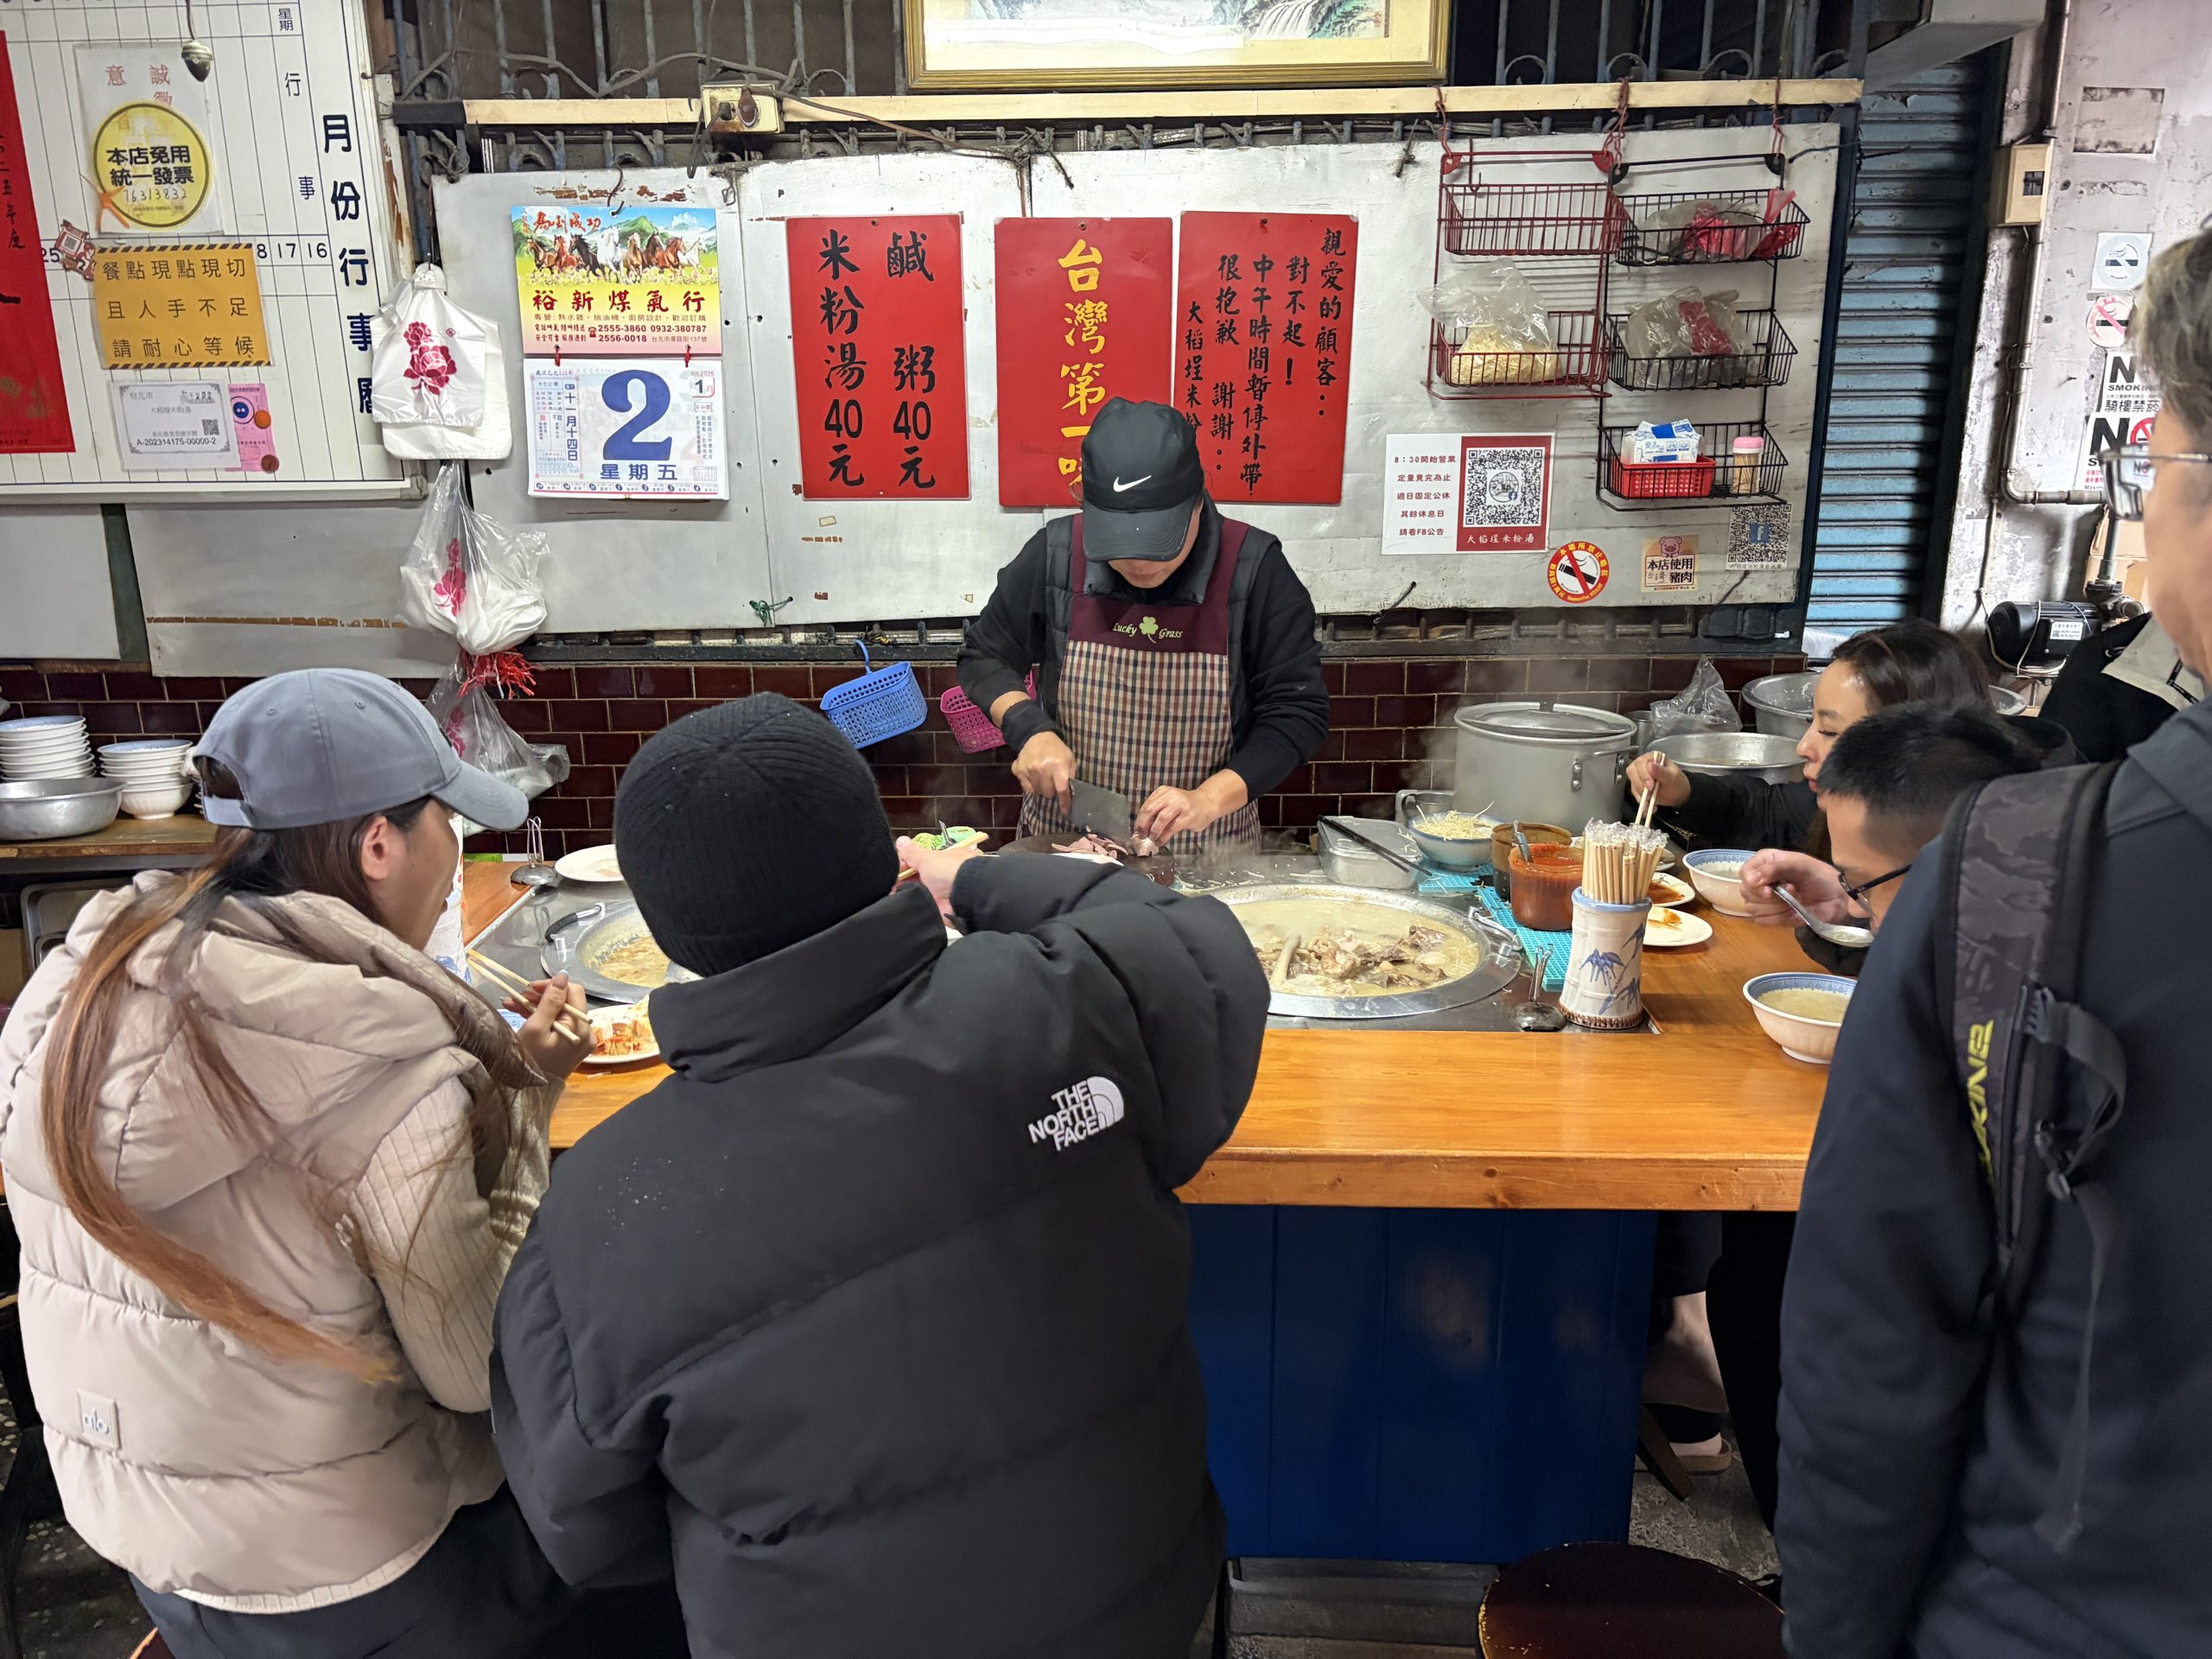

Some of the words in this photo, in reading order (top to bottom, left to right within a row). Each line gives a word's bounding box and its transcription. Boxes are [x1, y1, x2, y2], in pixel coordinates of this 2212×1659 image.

[277, 7, 295, 32] 星期
[105, 145, 191, 166] 本店免用
[109, 166, 194, 187] 統一發票
[277, 243, 297, 259] 17
[308, 243, 328, 259] 16
[102, 257, 246, 282] 餐點現點現切
[107, 297, 249, 319] 且人手不足
[532, 289, 705, 313] 裕新煤氣行
[1215, 254, 1243, 346] 很抱歉
[598, 324, 646, 333] 2555-3860
[651, 324, 707, 333] 0932-380787
[112, 335, 255, 359] 請耐心等候
[817, 229, 868, 486] 米粉湯40元
[1240, 254, 1274, 497] 中午時間暫停外帶
[601, 369, 673, 461] 2
[2104, 399, 2160, 413] 騎樓禁菸
[601, 463, 677, 481] 星期五
[1396, 492, 1451, 500] 週日固定公休
[1465, 533, 1535, 545] 大稻埕米粉湯
[1647, 558, 1693, 571] 本店使用
[1112, 622, 1137, 638] Lucky
[1159, 627, 1184, 639] Grass
[1051, 1079, 1091, 1110] THE
[1027, 1095, 1096, 1144] NORTH
[1052, 1114, 1101, 1152] FACE
